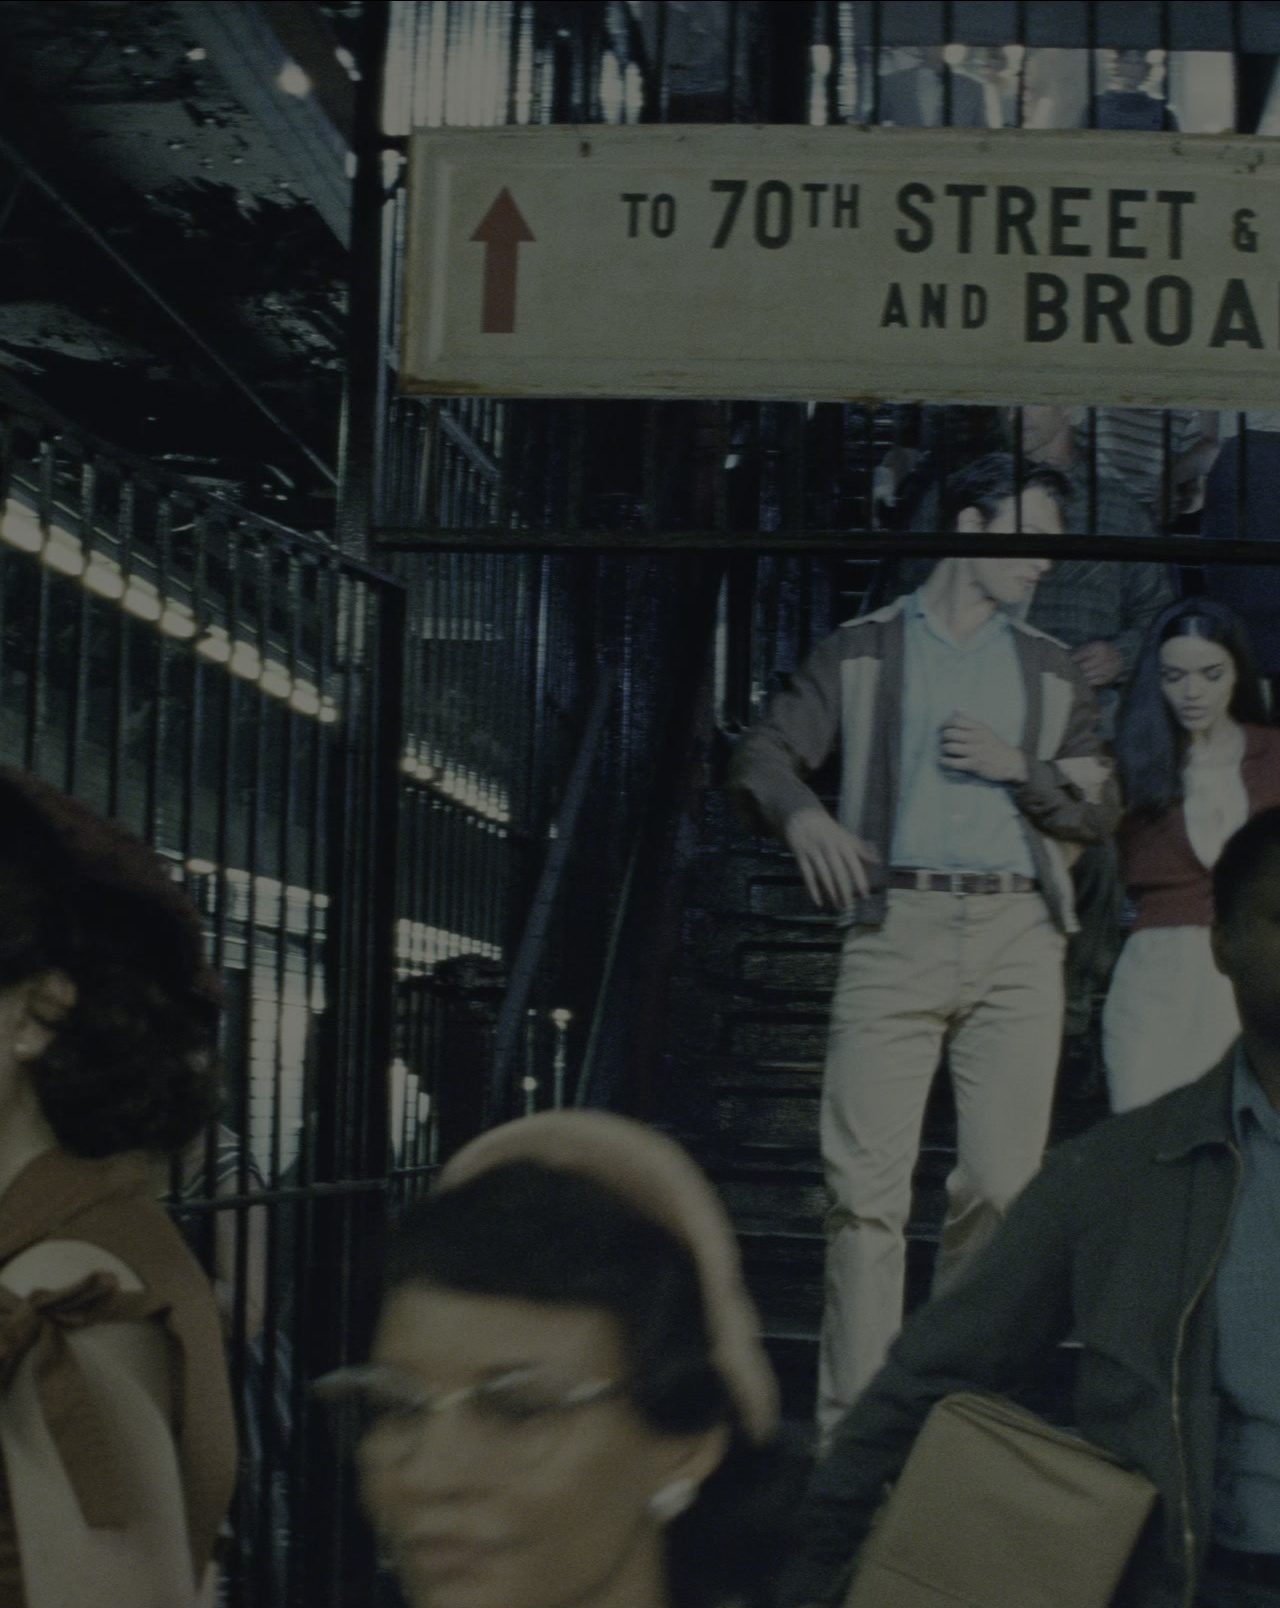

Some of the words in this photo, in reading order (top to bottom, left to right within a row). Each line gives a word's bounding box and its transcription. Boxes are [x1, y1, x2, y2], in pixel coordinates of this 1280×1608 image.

[620, 191, 678, 240] TO
[710, 179, 861, 250] 70TH
[894, 181, 1197, 261] STREET
[1231, 207, 1258, 254] &
[880, 282, 989, 330] AND
